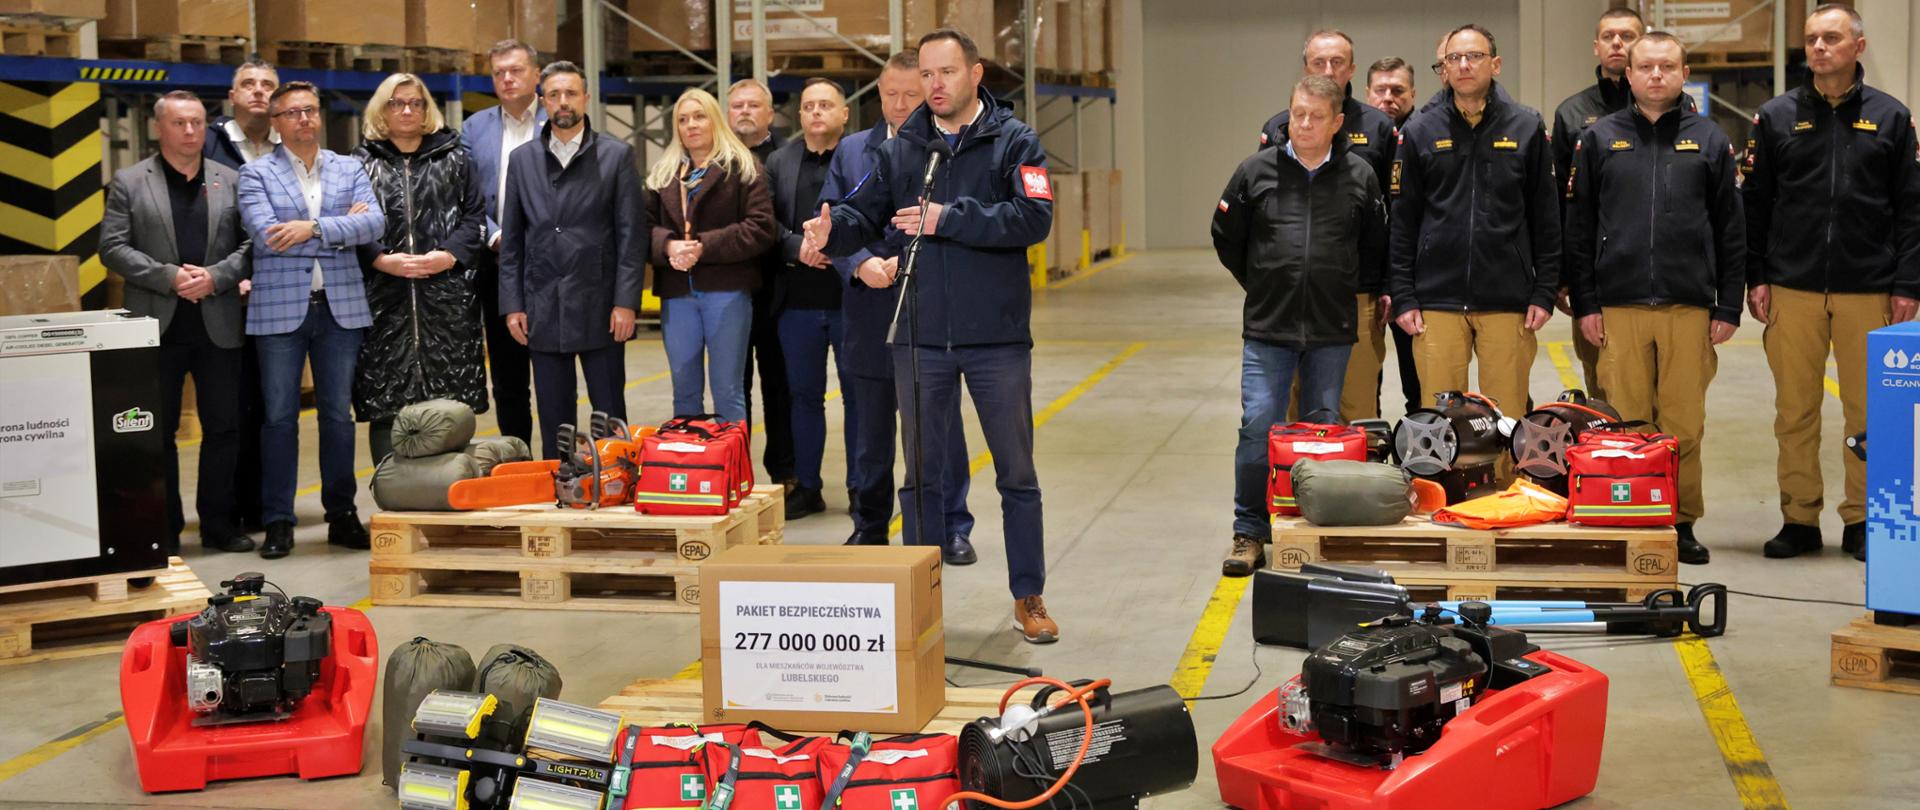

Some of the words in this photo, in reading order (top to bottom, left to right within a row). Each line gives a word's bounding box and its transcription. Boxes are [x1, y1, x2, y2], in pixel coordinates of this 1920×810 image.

[0, 424, 24, 433] rona
[27, 418, 70, 431] ludności
[25, 430, 65, 442] cywilna
[684, 545, 706, 557] EPAL
[1281, 552, 1304, 564] EPAL
[1639, 558, 1664, 571] EPAL
[736, 605, 776, 617] PAKIET
[779, 604, 882, 619] BEZPIECZEŃSTWA
[735, 632, 773, 651] 277
[779, 633, 817, 652] 000
[823, 634, 861, 652] 000
[867, 634, 886, 652] zł
[769, 662, 815, 671] MIESZKAŃCÓW
[816, 662, 865, 672] WOJEWÓDZTWA
[781, 673, 840, 684] LUBELSKIEGO
